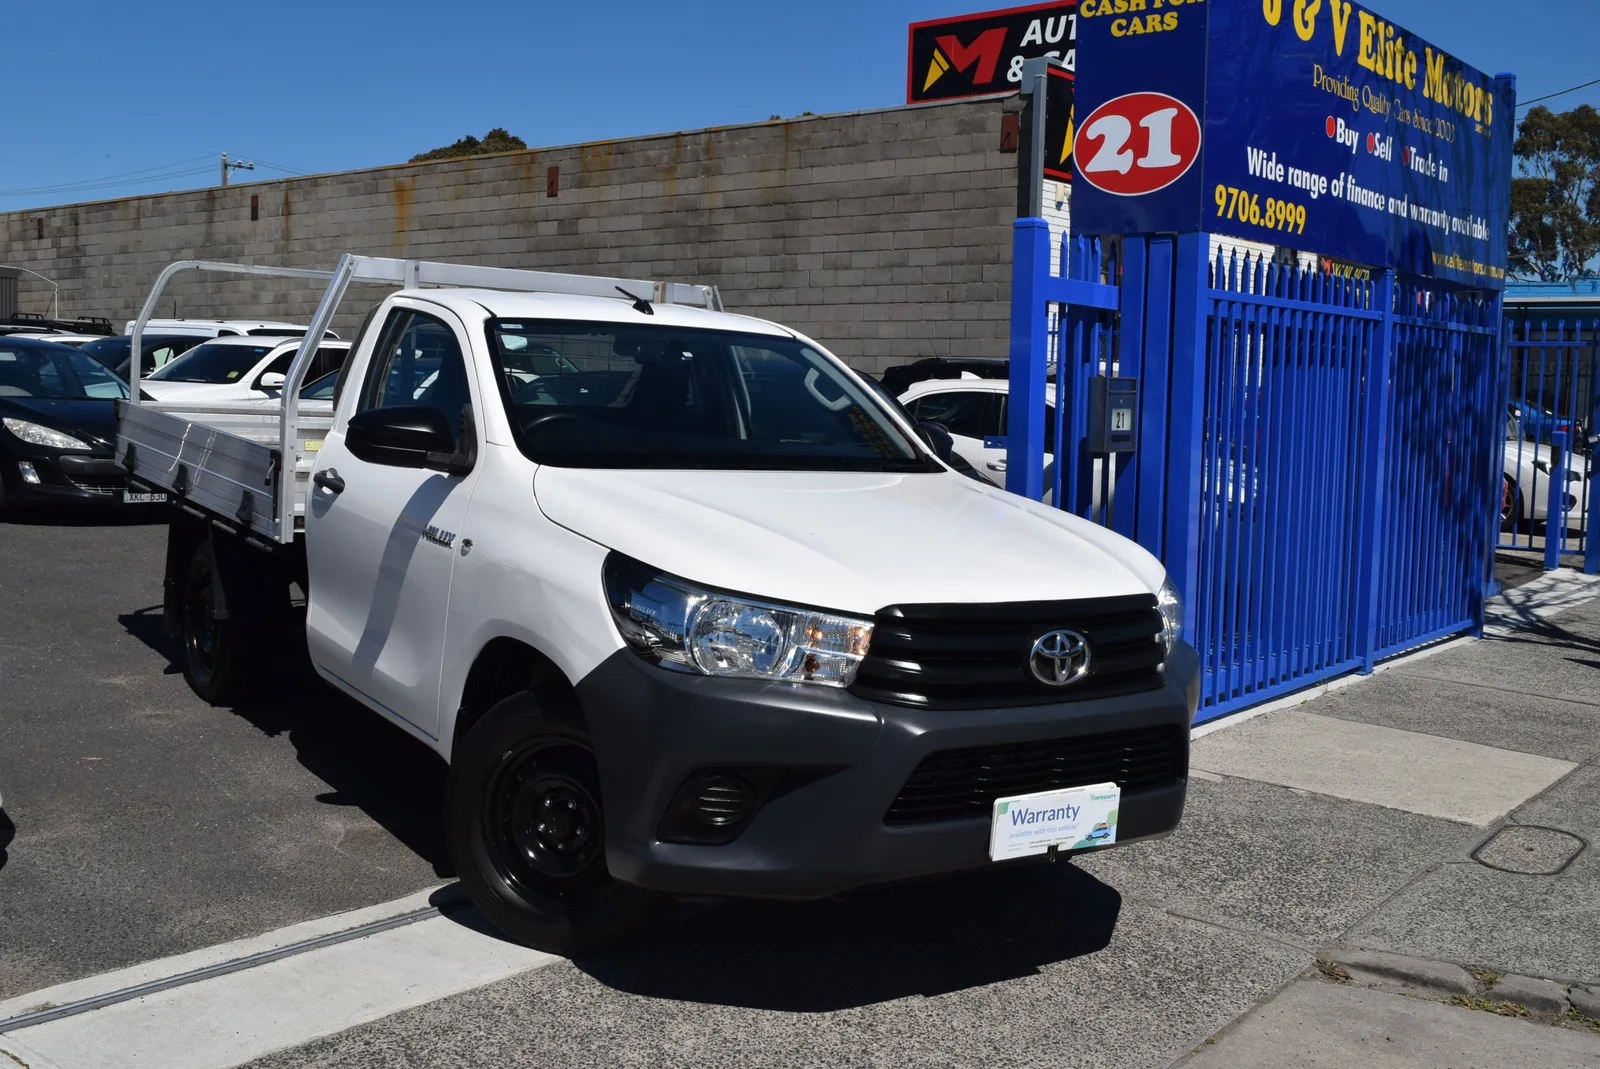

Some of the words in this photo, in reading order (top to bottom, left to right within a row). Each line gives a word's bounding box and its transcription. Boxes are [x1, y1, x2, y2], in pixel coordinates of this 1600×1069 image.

[1080, 0, 1147, 18] CASH
[1110, 11, 1179, 38] CARS
[1330, 0, 1352, 57] V
[1357, 9, 1417, 91] Elite
[1422, 46, 1494, 127] Motors
[1313, 63, 1360, 112] Providing
[1362, 85, 1391, 123] Quality
[1393, 99, 1411, 125] Cars
[1413, 107, 1433, 134] Since
[1084, 107, 1182, 175] 21
[1336, 117, 1360, 155] Buy
[1374, 132, 1393, 162] Sell
[1410, 145, 1437, 178] Trade
[1438, 159, 1448, 183] in
[1214, 183, 1306, 235] 9706.8999
[1247, 146, 1285, 183] Wide
[1288, 166, 1327, 200] range
[1331, 171, 1345, 199] of
[1346, 174, 1385, 212] finance
[1388, 193, 1408, 218] and
[1410, 203, 1451, 236] warranty
[1451, 214, 1490, 241] available
[1116, 411, 1125, 429] 21
[1008, 829, 1033, 839] available
[1034, 827, 1046, 835] with
[1047, 825, 1057, 833] this
[1011, 803, 1081, 827] Warranty
